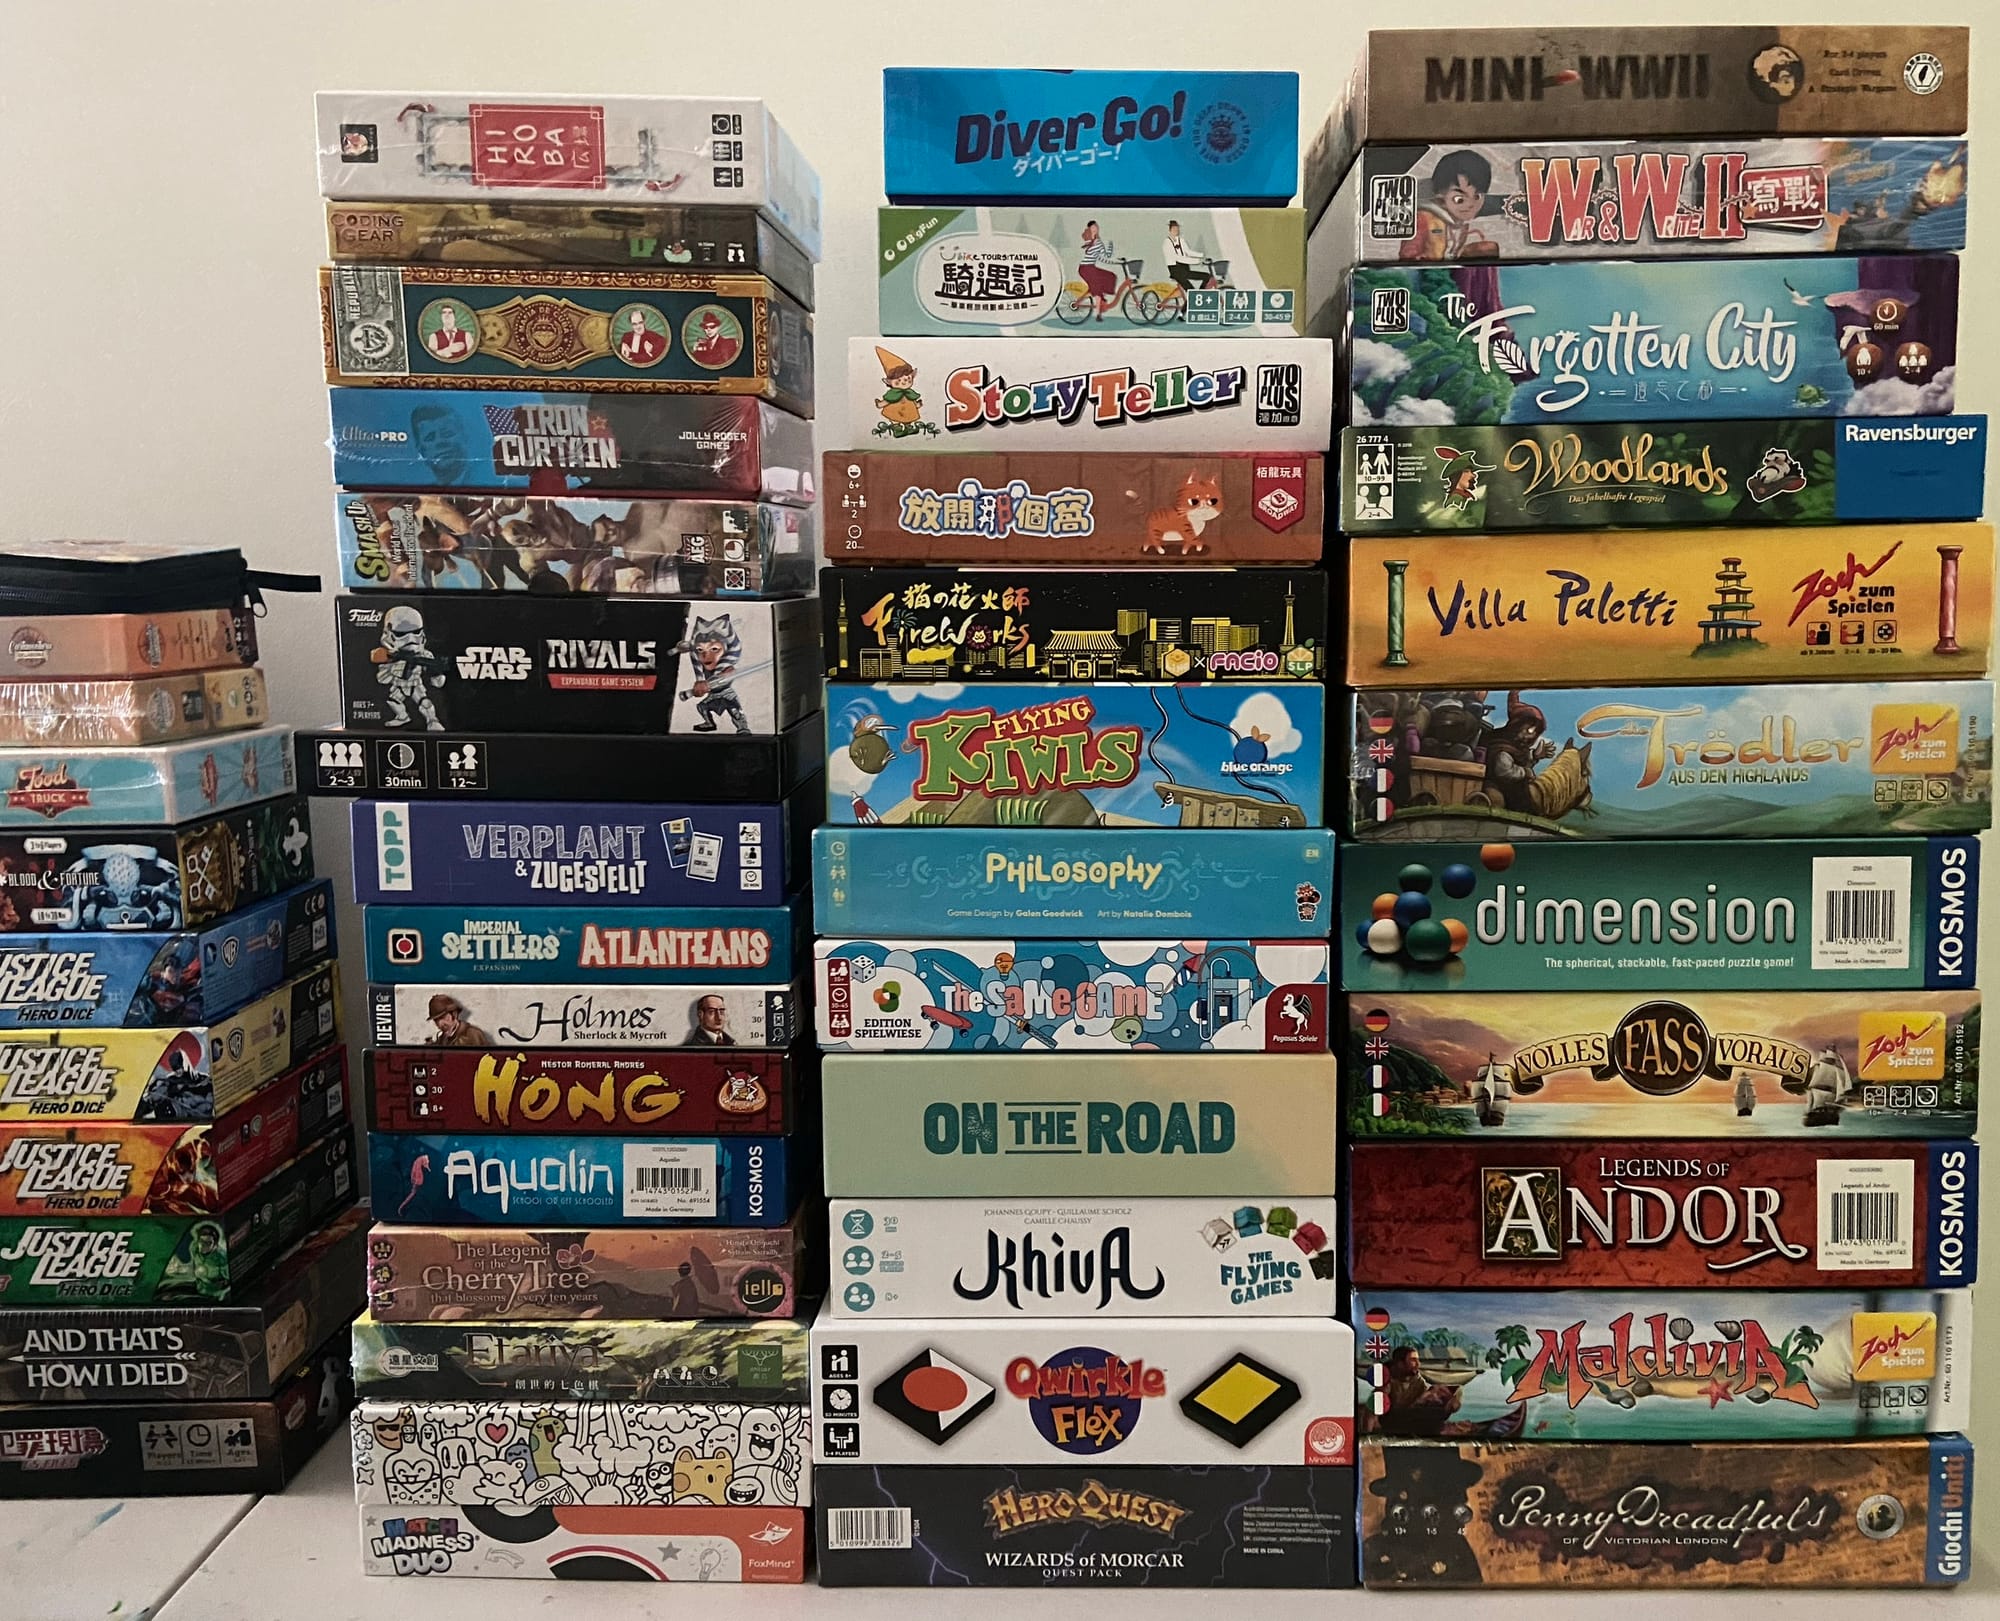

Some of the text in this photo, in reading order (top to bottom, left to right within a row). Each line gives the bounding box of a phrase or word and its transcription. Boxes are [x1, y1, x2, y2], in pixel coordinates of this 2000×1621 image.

[1424, 53, 1712, 103] MINI WWII
[955, 109, 1096, 164] Diver
[1102, 90, 1187, 147] Go!
[1378, 179, 1412, 199] TWO
[1746, 173, 1822, 216] 寫戰
[331, 213, 404, 227] CODING
[341, 229, 393, 241] GEAR
[935, 263, 1044, 301] 騎遇記
[1378, 290, 1405, 308] TWO
[1375, 306, 1406, 327] PLUS
[1439, 293, 1478, 323] The
[1706, 301, 1798, 383] City
[521, 404, 590, 437] IRON
[678, 432, 747, 444] JOLLY ROGER
[1368, 435, 1381, 443] 777
[1844, 424, 1978, 444] Ravensburger
[500, 435, 618, 469] CURTAIN
[696, 441, 730, 451] GAMES
[1503, 432, 1729, 498] Woodlands
[848, 480, 860, 489] 6+
[1568, 493, 1666, 504] Das fabelhafte Legespiel
[345, 501, 390, 581] SMASH UP
[691, 536, 705, 563] AEG
[1859, 585, 1895, 597] zum
[1427, 569, 1679, 637] Villa Paletti
[1828, 599, 1895, 617] Spielen
[348, 609, 383, 622] Funko
[456, 647, 532, 665] STAR
[546, 639, 657, 670] RIVALS
[456, 663, 532, 680] WARS
[1288, 662, 1313, 670] SLP
[601, 676, 645, 687] GAME SYSTEM
[991, 698, 1093, 740] FLYING
[1577, 704, 1865, 789] Trödler
[1920, 740, 1946, 748] zum
[914, 712, 1139, 797] KIWIS
[1900, 749, 1946, 761] Spielen
[19, 763, 68, 790] Food
[1220, 760, 1253, 774] blue
[1255, 761, 1294, 775] orange
[1668, 770, 1728, 785] AUS DEN
[385, 777, 422, 787] 30min
[31, 792, 67, 804] TRUCK
[383, 809, 406, 885] TOPP
[461, 823, 646, 861] VERPLANT
[8, 870, 100, 890] BLOOD & FORTUNE
[514, 859, 648, 895] & ZUGESTELLT
[947, 909, 1014, 919] Game Design by
[1098, 910, 1154, 919] Art by Natalie
[1475, 883, 1796, 946] dimension
[1938, 848, 1967, 976] KOSMOS
[464, 919, 523, 935] IMPERIAL
[441, 932, 560, 961] SETTLERS
[580, 924, 770, 968] ATLANTEANS
[473, 964, 522, 972] EXPANSION
[1544, 957, 1794, 969] The spherical, stackable, fast-paced puzzle game!
[17, 1006, 96, 1022] HERO DICE
[376, 1004, 393, 1041] DEVIR
[497, 995, 656, 1044] Holmes
[864, 1019, 911, 1028] EDITION
[574, 1030, 668, 1041] Sherlock & Mycroft
[855, 1029, 922, 1038] SPIELWIESE
[1272, 1034, 1318, 1043] Pegasus Spiele
[1516, 1017, 1807, 1077] VOLLES FASS VORAUS
[1909, 1047, 1934, 1055] zum
[575, 1060, 611, 1068] ROMERAL
[1888, 1056, 1934, 1068] Spielen
[473, 1052, 686, 1127] HONG
[29, 1101, 105, 1114] HERO DICE
[923, 1101, 1236, 1155] ON THE ROAD
[1599, 1156, 1730, 1178] LEGENDS OF
[443, 1149, 614, 1214] Aqualin
[749, 1145, 763, 1216] KOSMOS
[45, 1196, 120, 1209] HERO DICE
[984, 1208, 1100, 1216] JOHANNES GUILLAUME
[1024, 1217, 1092, 1225] CAMILLE CHAUSSY
[1487, 1173, 1807, 1270] ANDOR
[1939, 1151, 1967, 1276] KOSMOS
[1, 1226, 135, 1260] JUSTICE
[453, 1242, 551, 1264] The Legend
[474, 1259, 506, 1270] of the
[1248, 1251, 1273, 1263] THE
[30, 1252, 145, 1285] LEAGUE
[1220, 1261, 1302, 1286] FLYING
[58, 1283, 135, 1296] HERO DICE
[422, 1259, 589, 1313] Cherry Tree
[744, 1280, 783, 1296] iello
[1230, 1280, 1293, 1305] GAMES
[431, 1293, 598, 1304] that blossoms every ten years
[23, 1328, 184, 1352] AND THAT'S
[1881, 1356, 1925, 1367] Spielen
[1901, 1348, 1925, 1356] zum
[26, 1362, 189, 1388] HOW I DIED
[1005, 1355, 1166, 1402] Qwirkle
[1052, 1404, 1123, 1447] Flex
[1500, 1485, 1827, 1550] Penny Dreadfuls
[373, 1533, 472, 1556] MADNESS
[1563, 1535, 1728, 1545] OF VICTORIAN LONDON
[1938, 1510, 1963, 1576] Giochi
[394, 1550, 450, 1575] DUO
[748, 1559, 791, 1568] FoxMind
[984, 1551, 1185, 1569] WIZARDS of MORCAR
[1042, 1568, 1123, 1578] QUEST PACK
